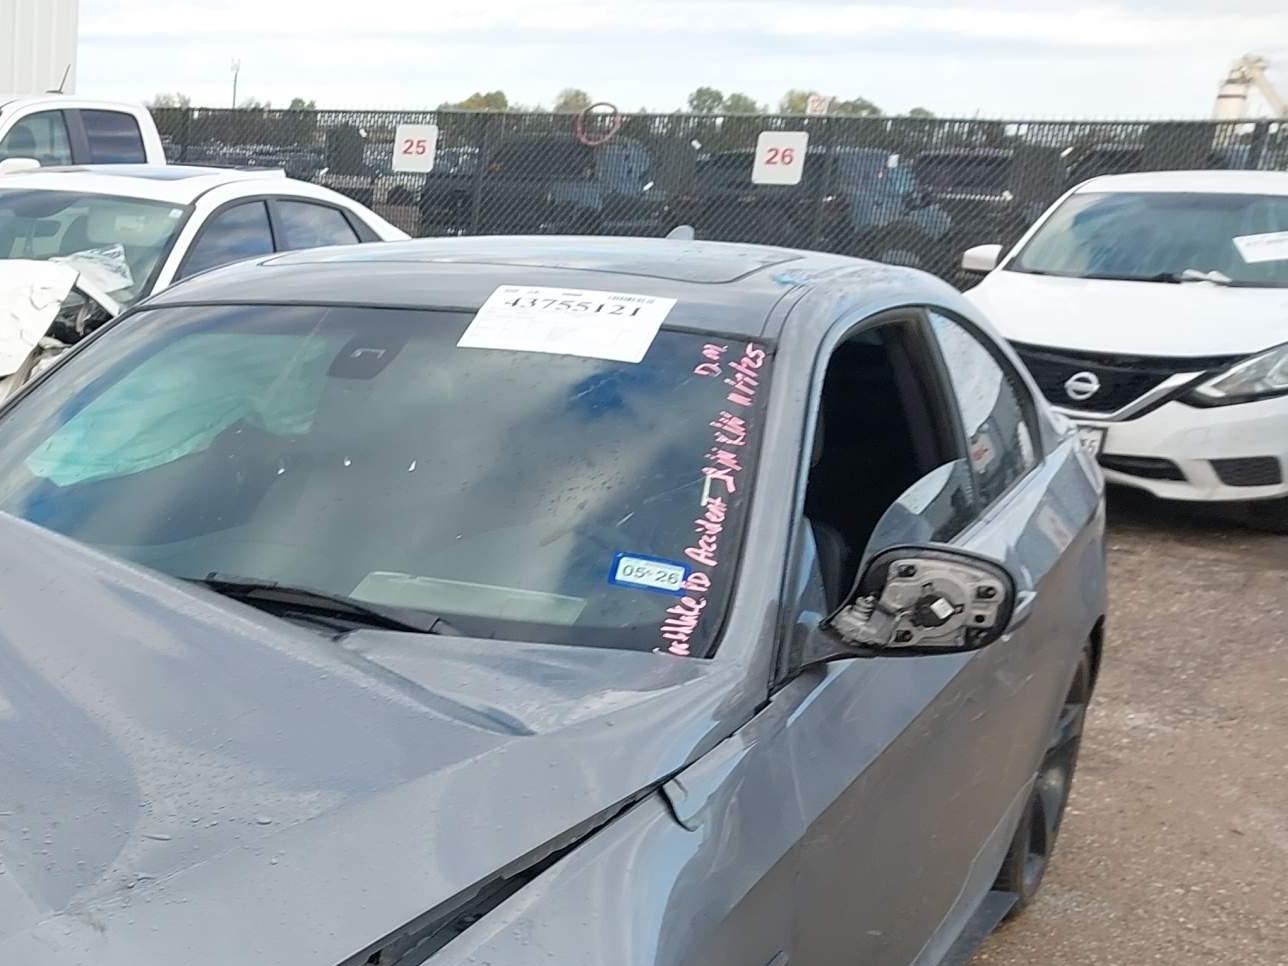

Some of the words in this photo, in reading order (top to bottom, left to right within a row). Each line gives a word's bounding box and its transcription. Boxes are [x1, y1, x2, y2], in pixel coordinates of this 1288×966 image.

[401, 138, 427, 156] 25
[764, 147, 795, 166] 26
[504, 296, 643, 318] 43755121
